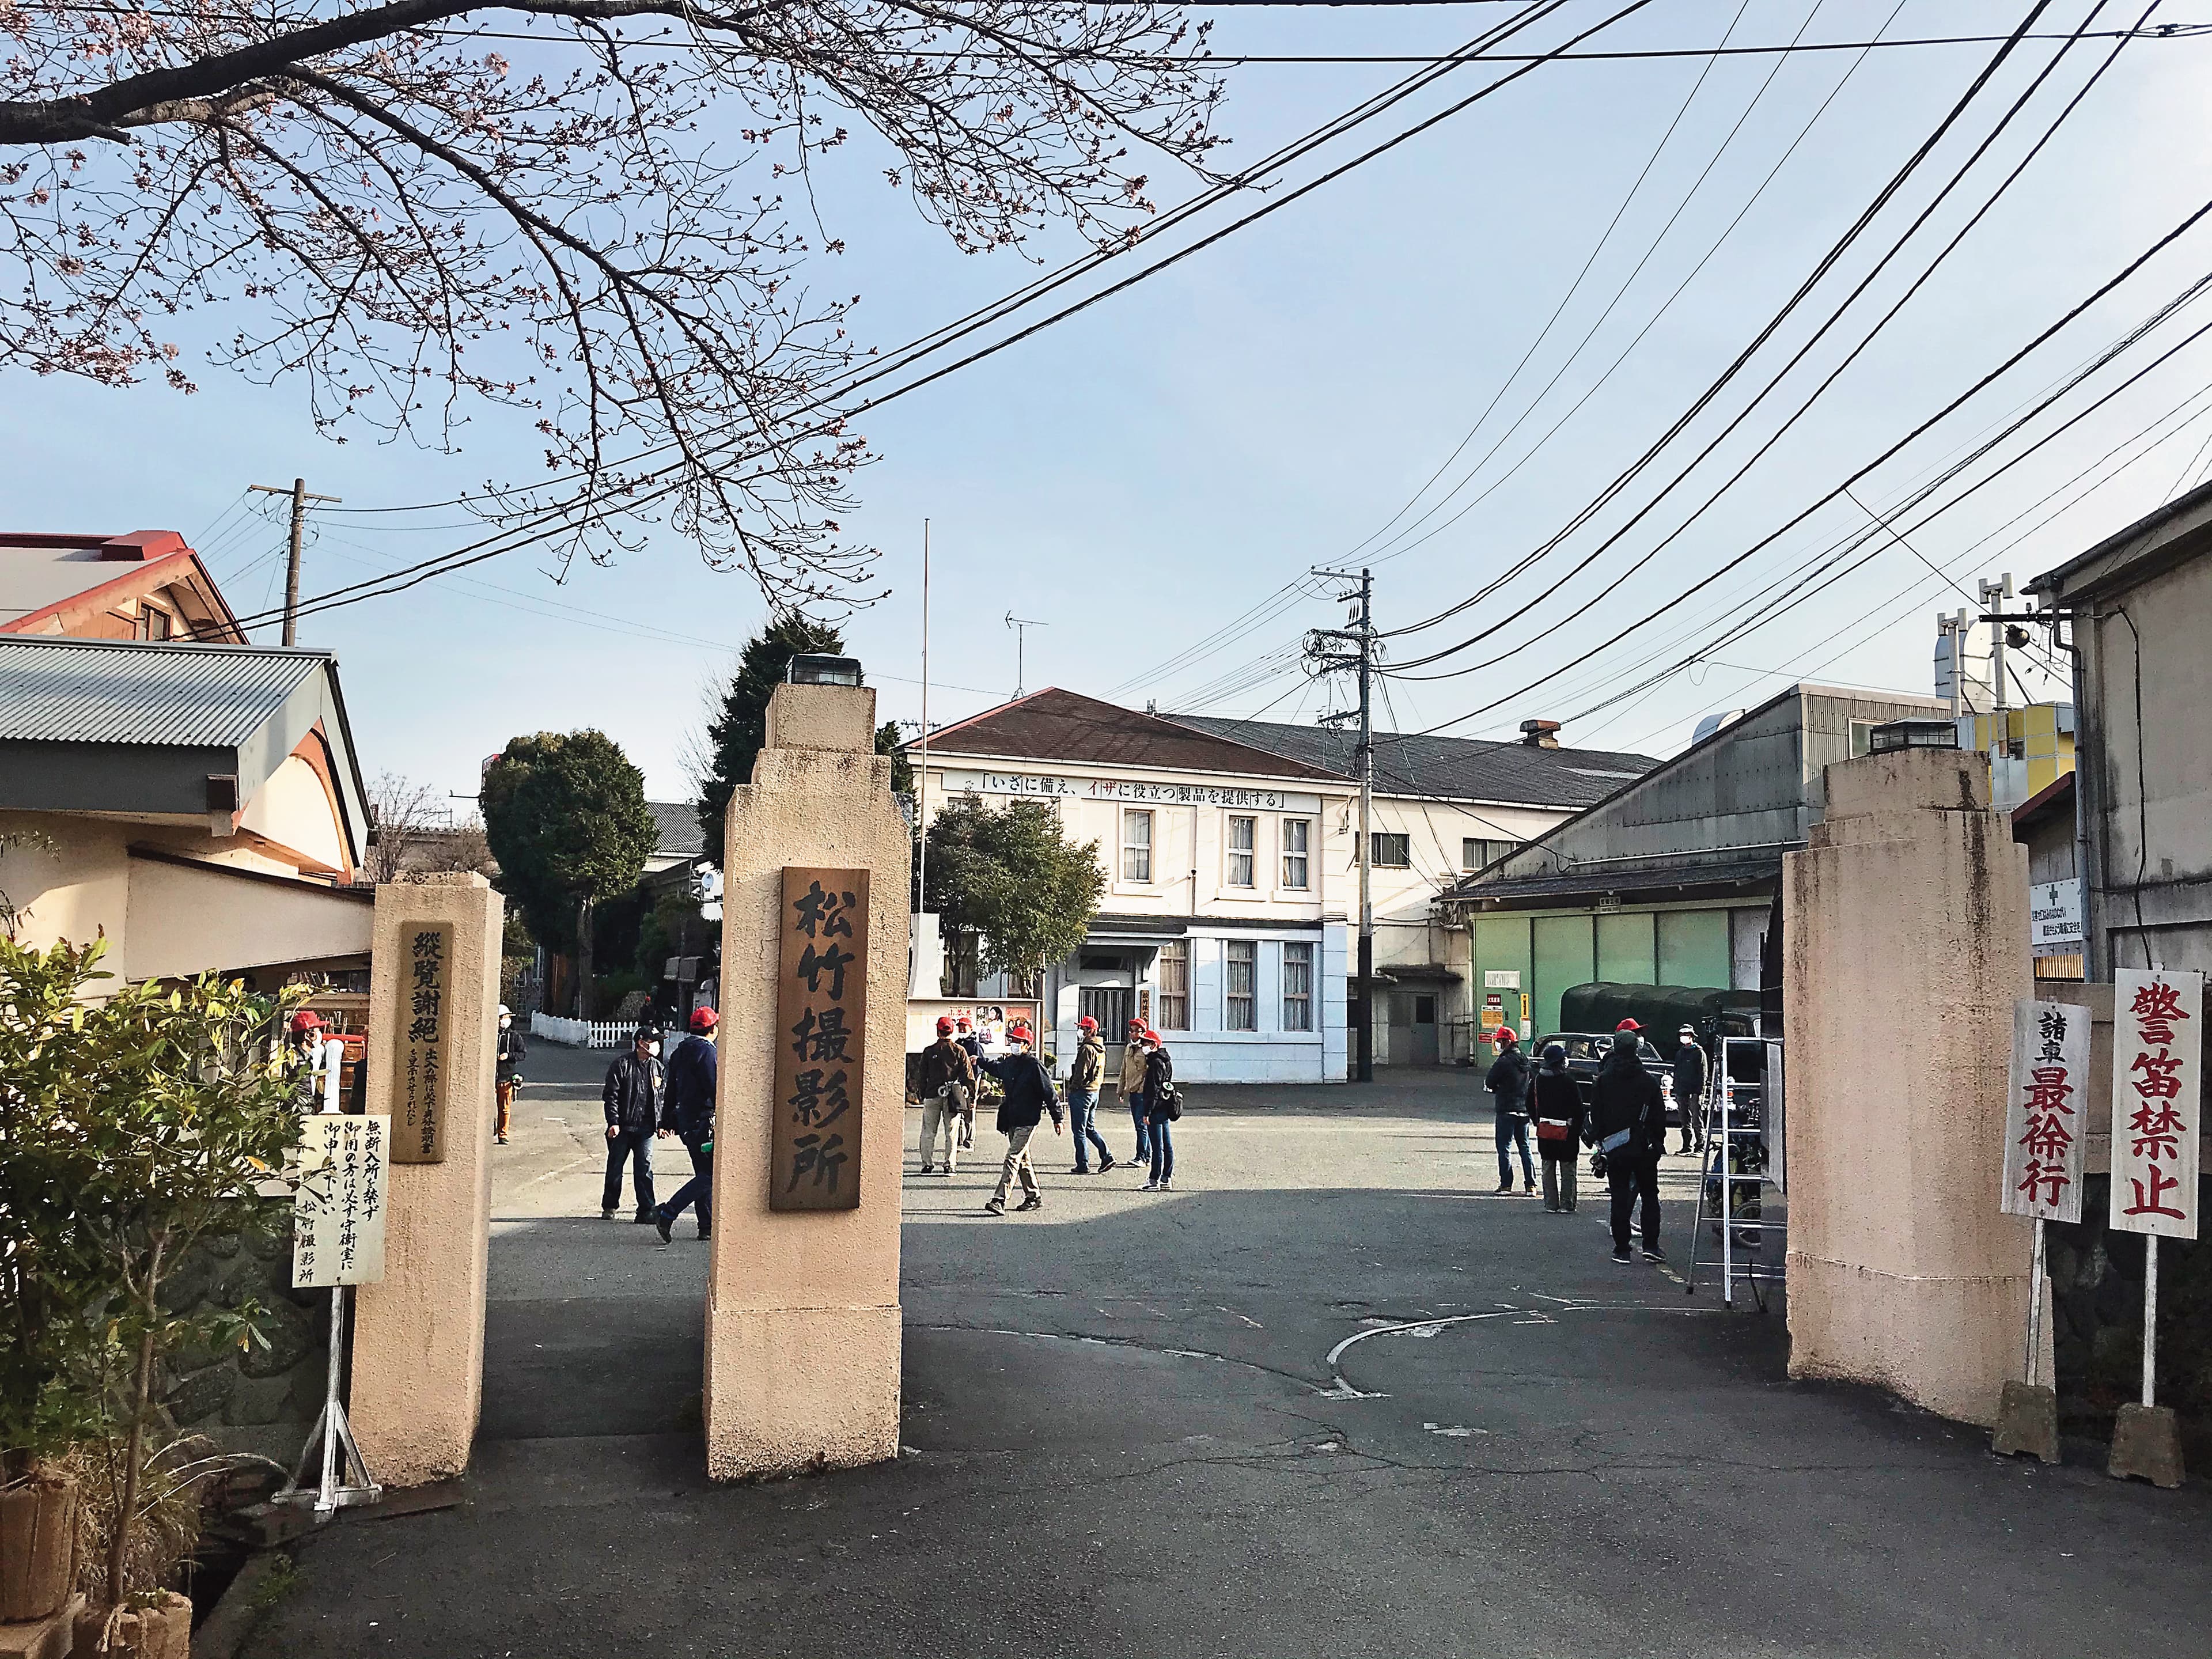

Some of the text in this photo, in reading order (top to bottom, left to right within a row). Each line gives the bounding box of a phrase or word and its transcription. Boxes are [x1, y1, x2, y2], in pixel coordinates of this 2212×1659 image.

[787, 880, 857, 1194] 松竹撮影所
[2122, 982, 2191, 1220] 警笛禁止
